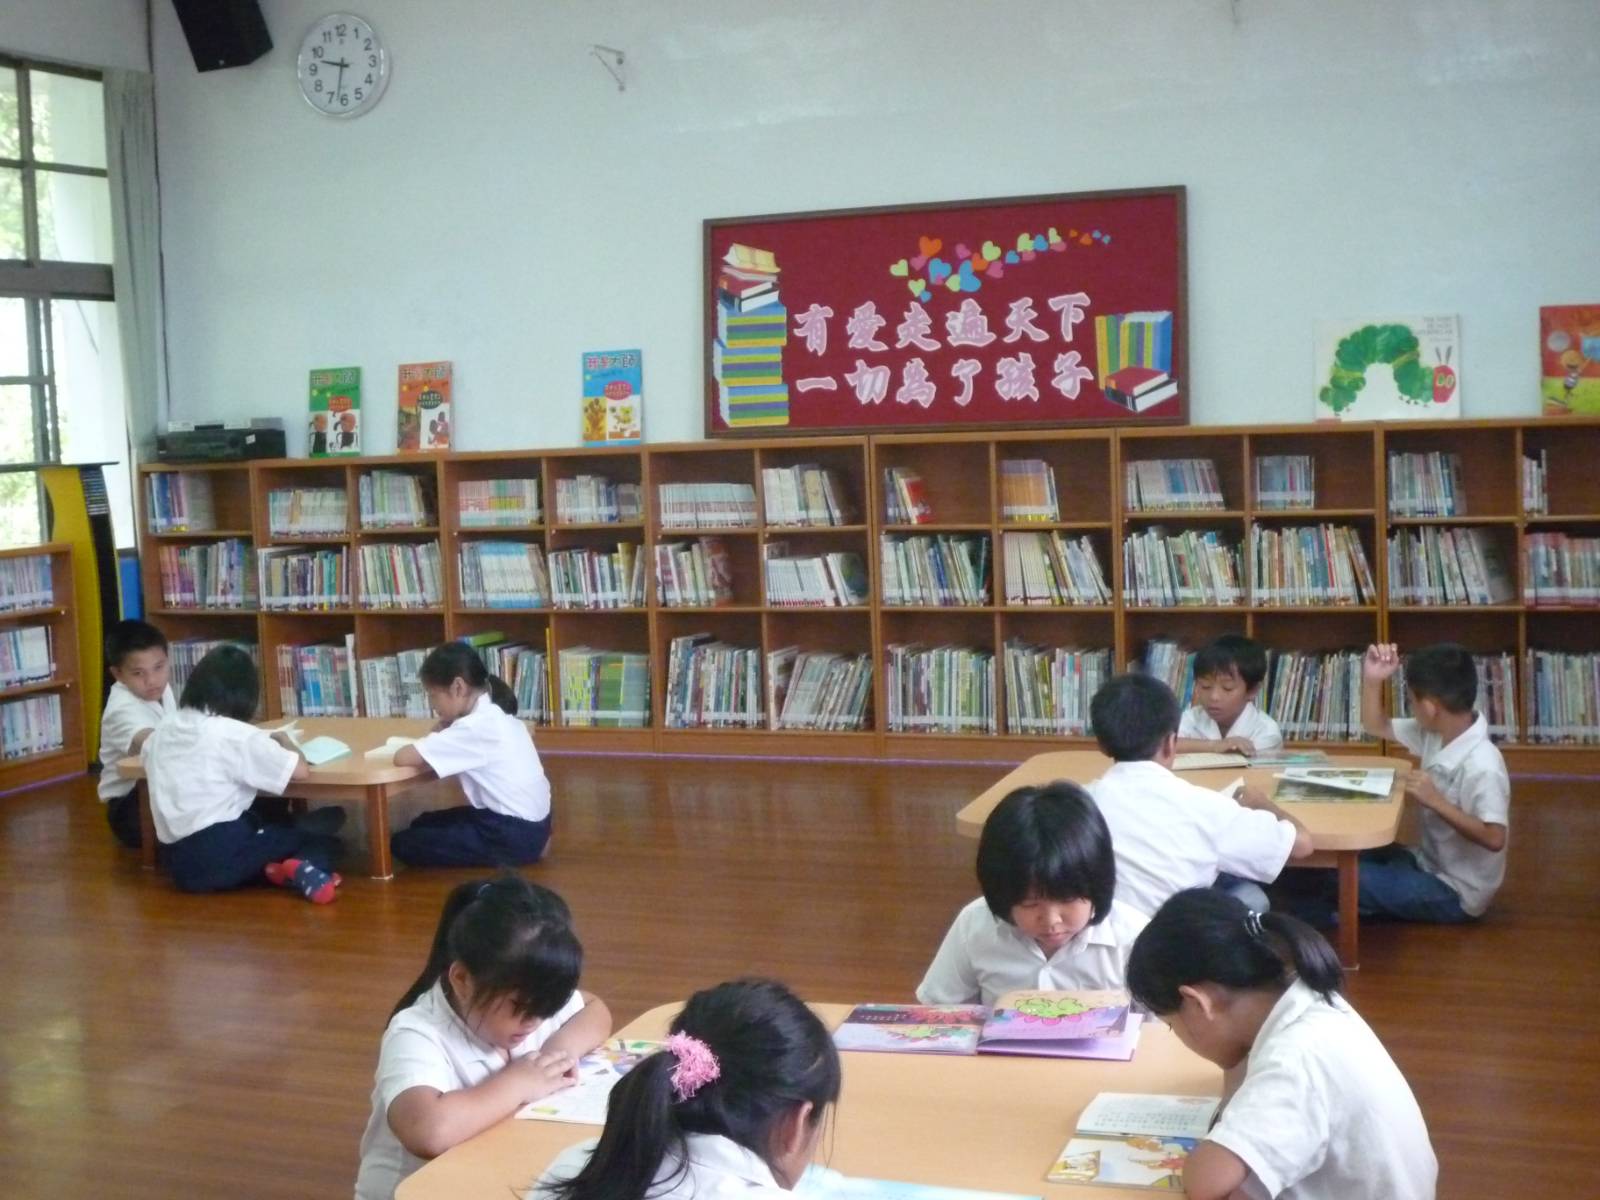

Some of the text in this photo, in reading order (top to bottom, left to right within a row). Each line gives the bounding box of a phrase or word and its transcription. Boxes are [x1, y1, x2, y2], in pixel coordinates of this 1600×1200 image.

[322, 31, 332, 43] 11
[335, 24, 347, 37] 12
[354, 27, 359, 39] 1
[364, 38, 372, 51] 2
[312, 46, 324, 58] 10
[368, 54, 377, 68] 3
[309, 63, 318, 76] 9
[364, 73, 373, 85] 4
[314, 79, 323, 93] 8
[326, 91, 335, 104] 7
[340, 93, 349, 106] 6
[354, 87, 363, 101] 5
[793, 292, 1091, 356] 有愛走遍天下
